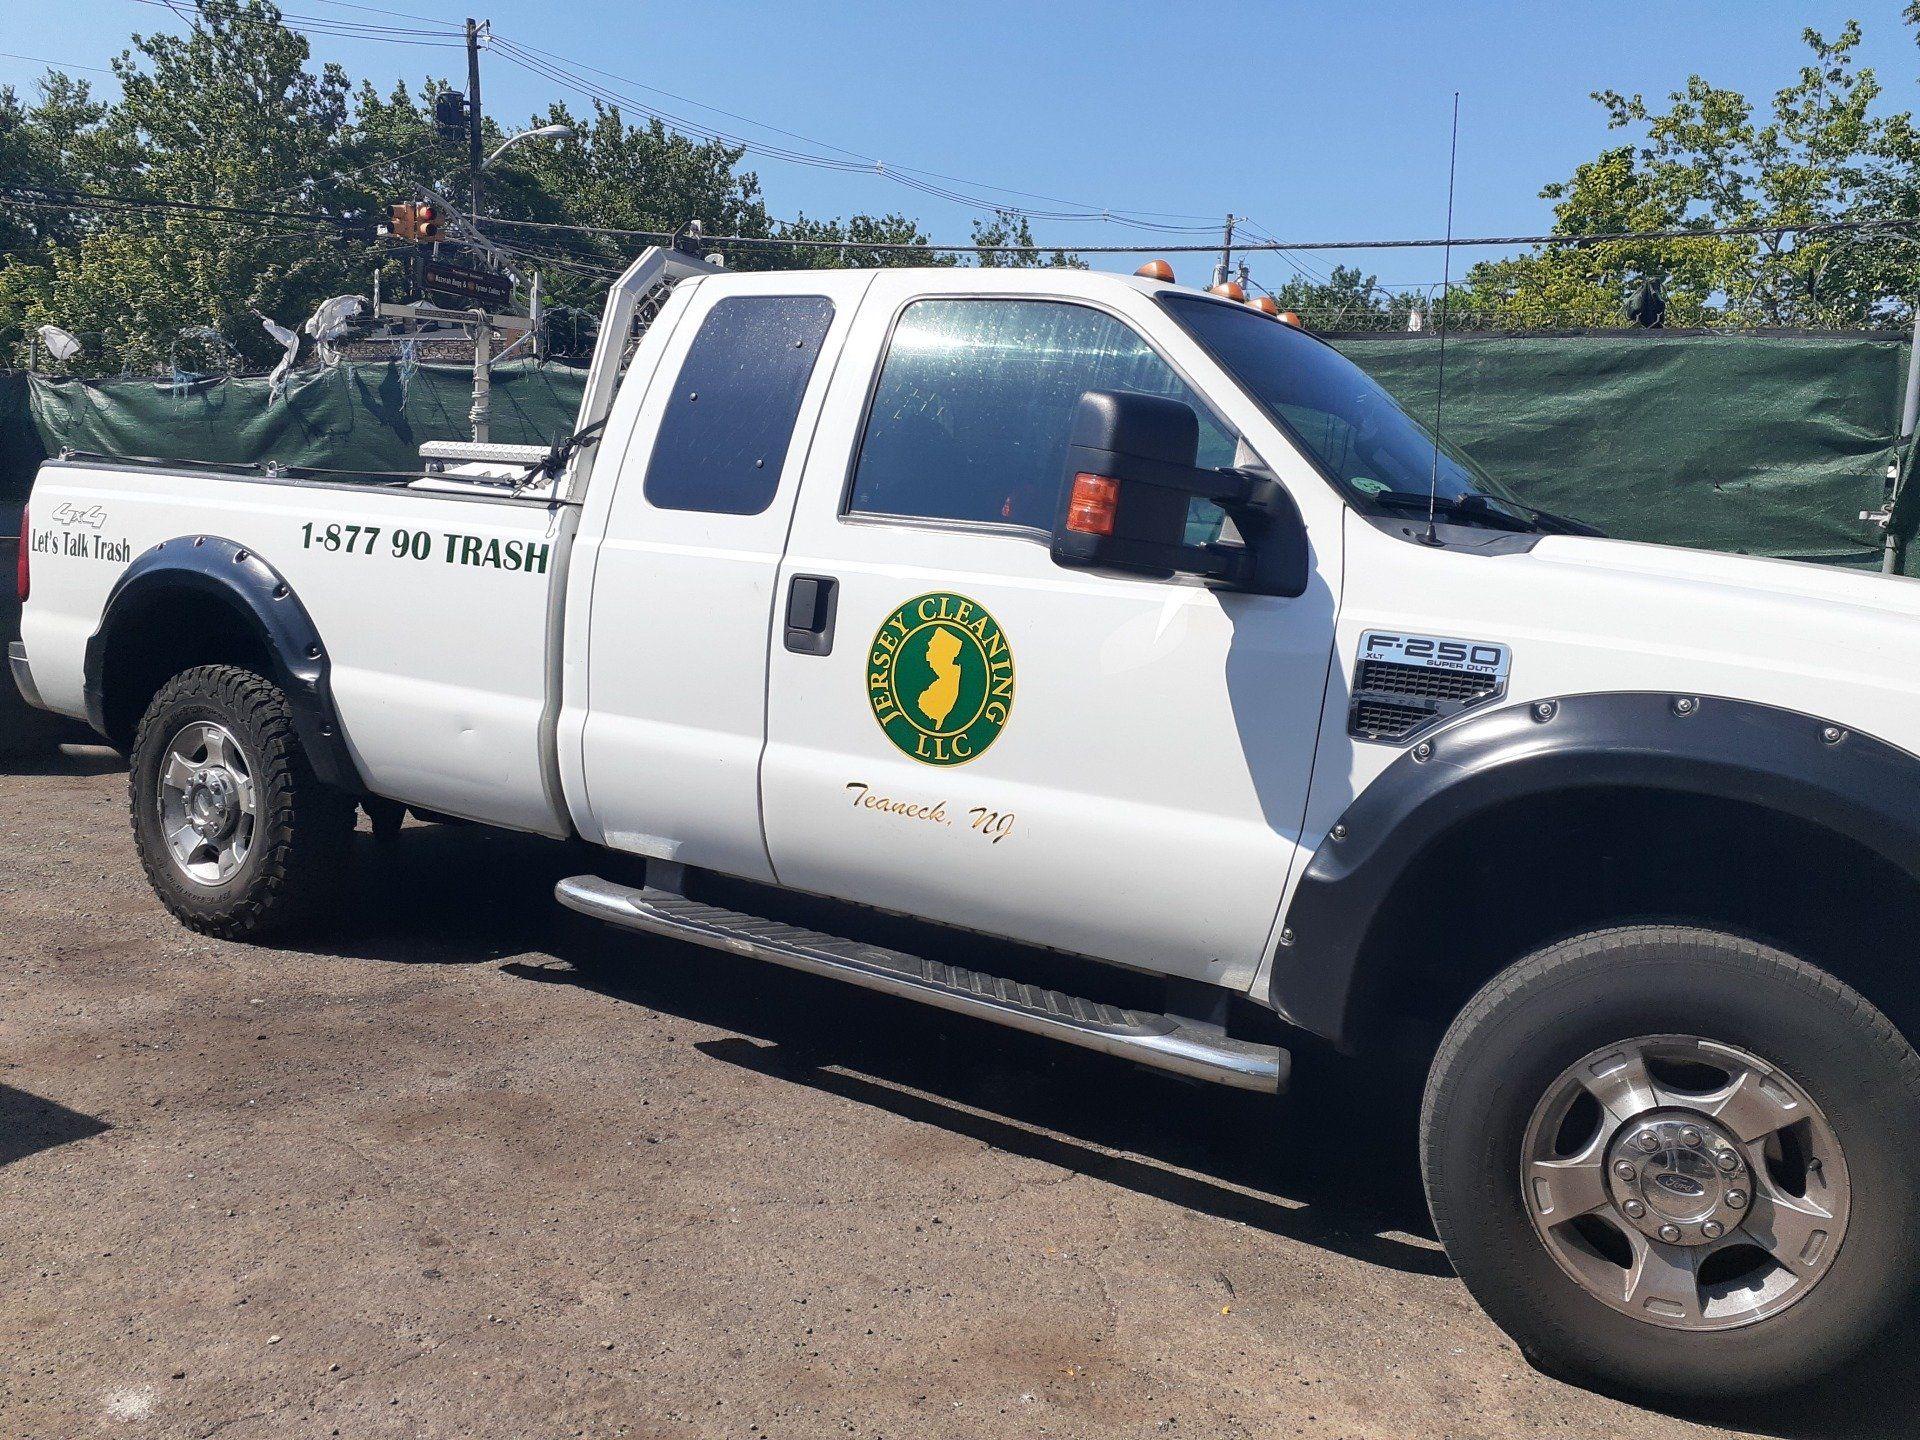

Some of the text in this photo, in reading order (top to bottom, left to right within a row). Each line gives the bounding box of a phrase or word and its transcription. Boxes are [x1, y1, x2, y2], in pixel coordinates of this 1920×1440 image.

[52, 502, 107, 529] 4x4
[32, 528, 130, 563] Let's Talk Trash
[301, 522, 550, 574] 1-877 90 TRASH
[870, 597, 1014, 727] JERSEY CLEANING
[1365, 652, 1385, 661] XLT
[1366, 634, 1502, 666] F-250
[1426, 659, 1498, 673] SUPER DUTY
[914, 733, 972, 760] LLC
[846, 782, 1016, 844] Teaneck, NJ
[1665, 1176, 1695, 1192] Ford
